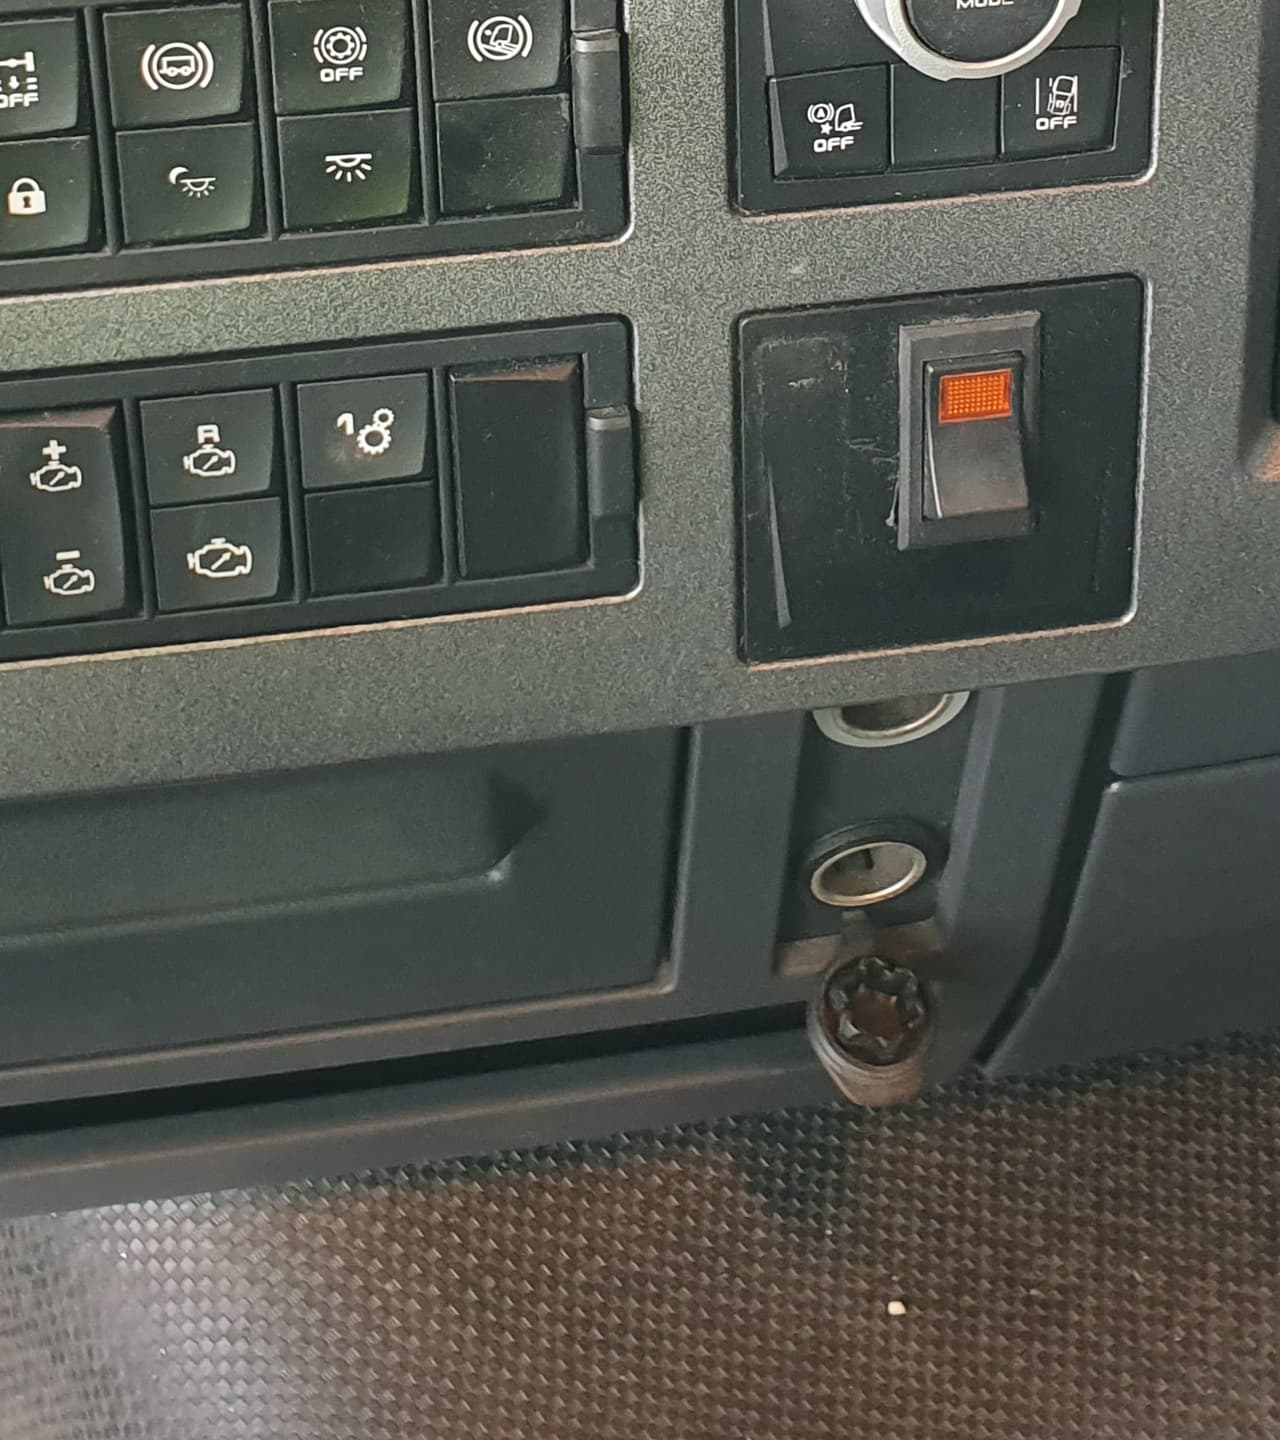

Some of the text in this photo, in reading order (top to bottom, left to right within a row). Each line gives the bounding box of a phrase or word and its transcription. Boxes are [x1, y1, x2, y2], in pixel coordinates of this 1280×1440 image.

[320, 66, 364, 83] OFF
[1035, 116, 1077, 131] OFF
[813, 136, 854, 152] OFF
[336, 412, 355, 436] 1
